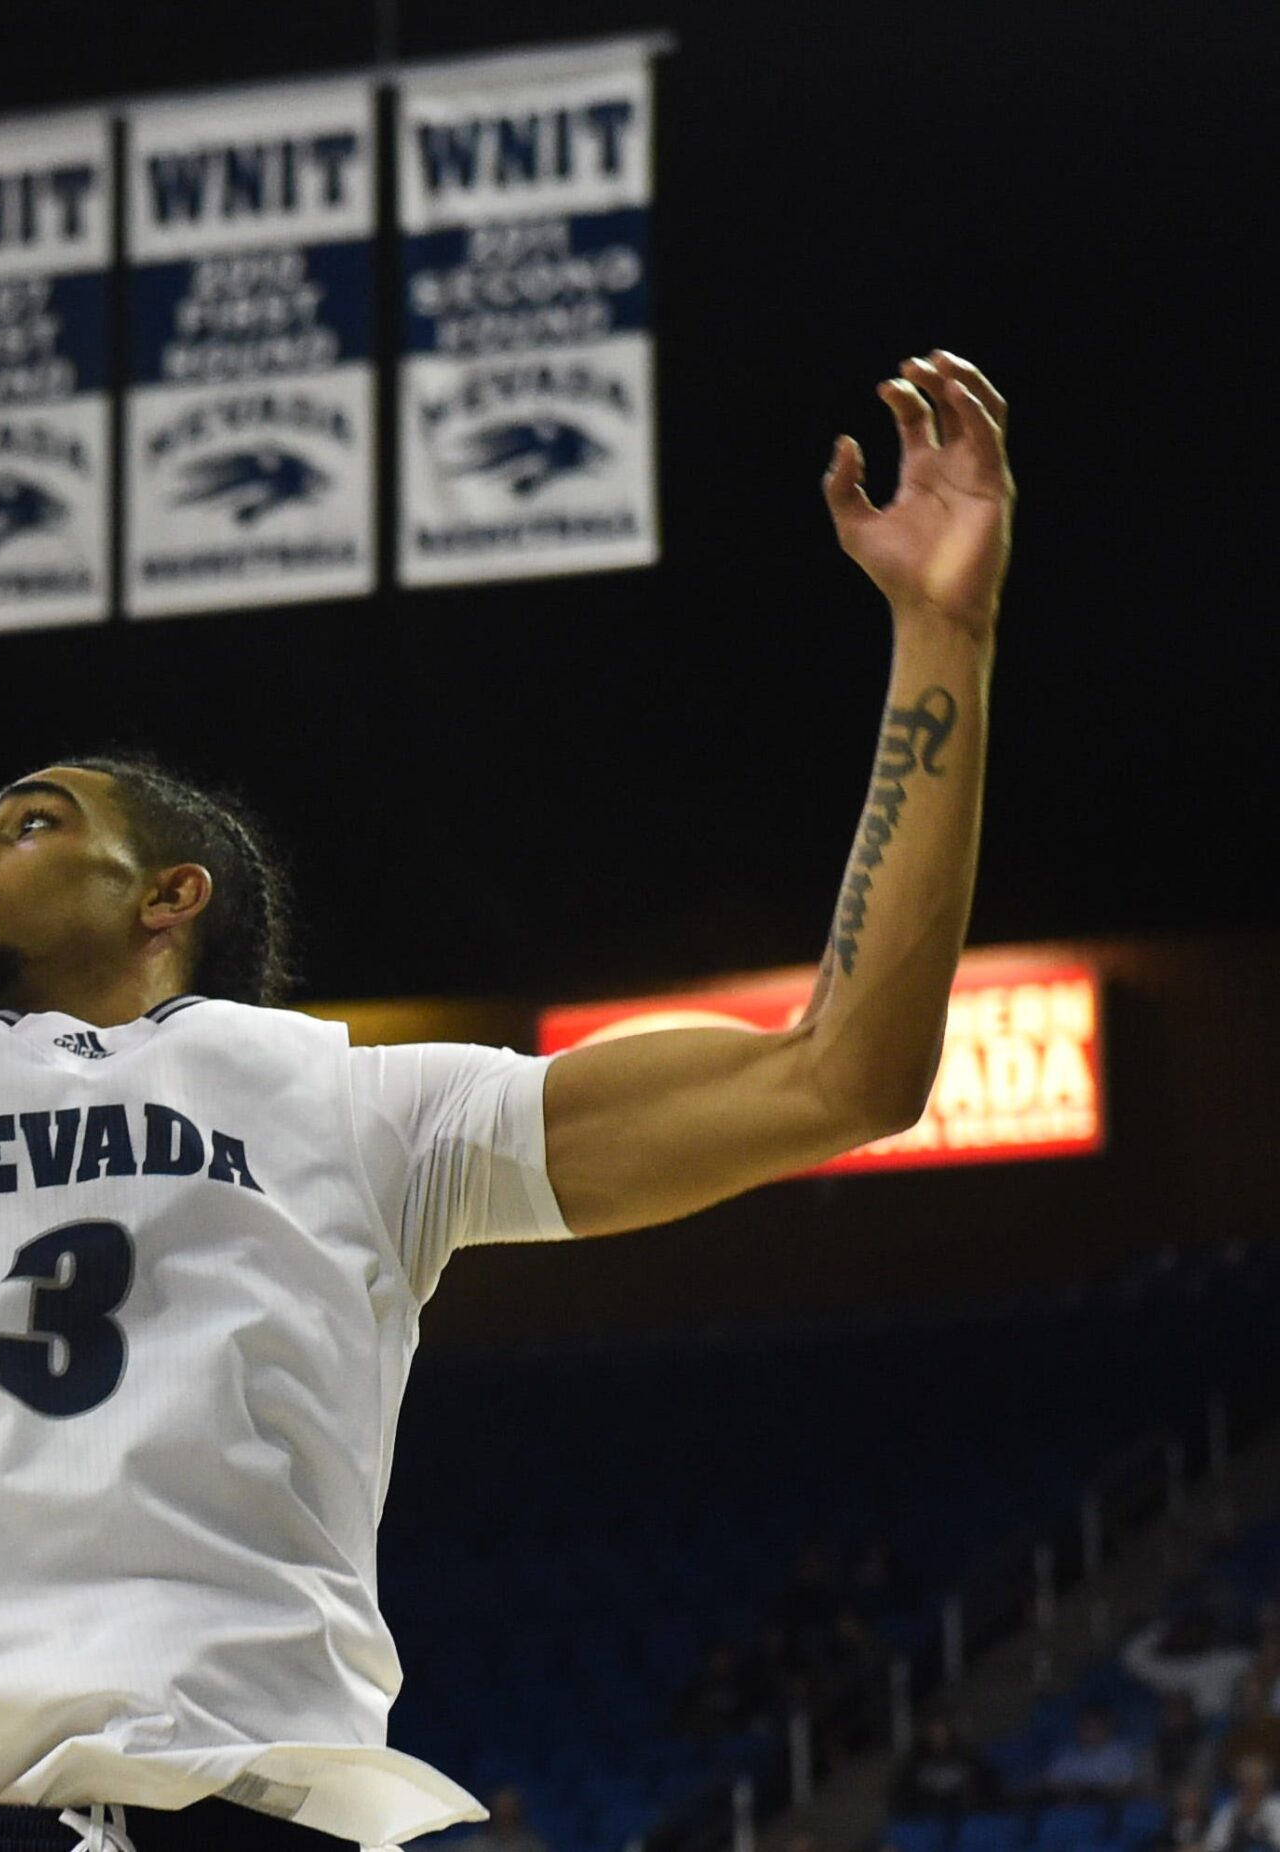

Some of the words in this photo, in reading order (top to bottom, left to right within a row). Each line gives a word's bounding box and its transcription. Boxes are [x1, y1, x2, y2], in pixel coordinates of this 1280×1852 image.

[148, 131, 356, 226] WNIT
[420, 100, 631, 195] WNIT
[148, 387, 354, 460] NEVADA
[420, 362, 632, 427] NEVADA
